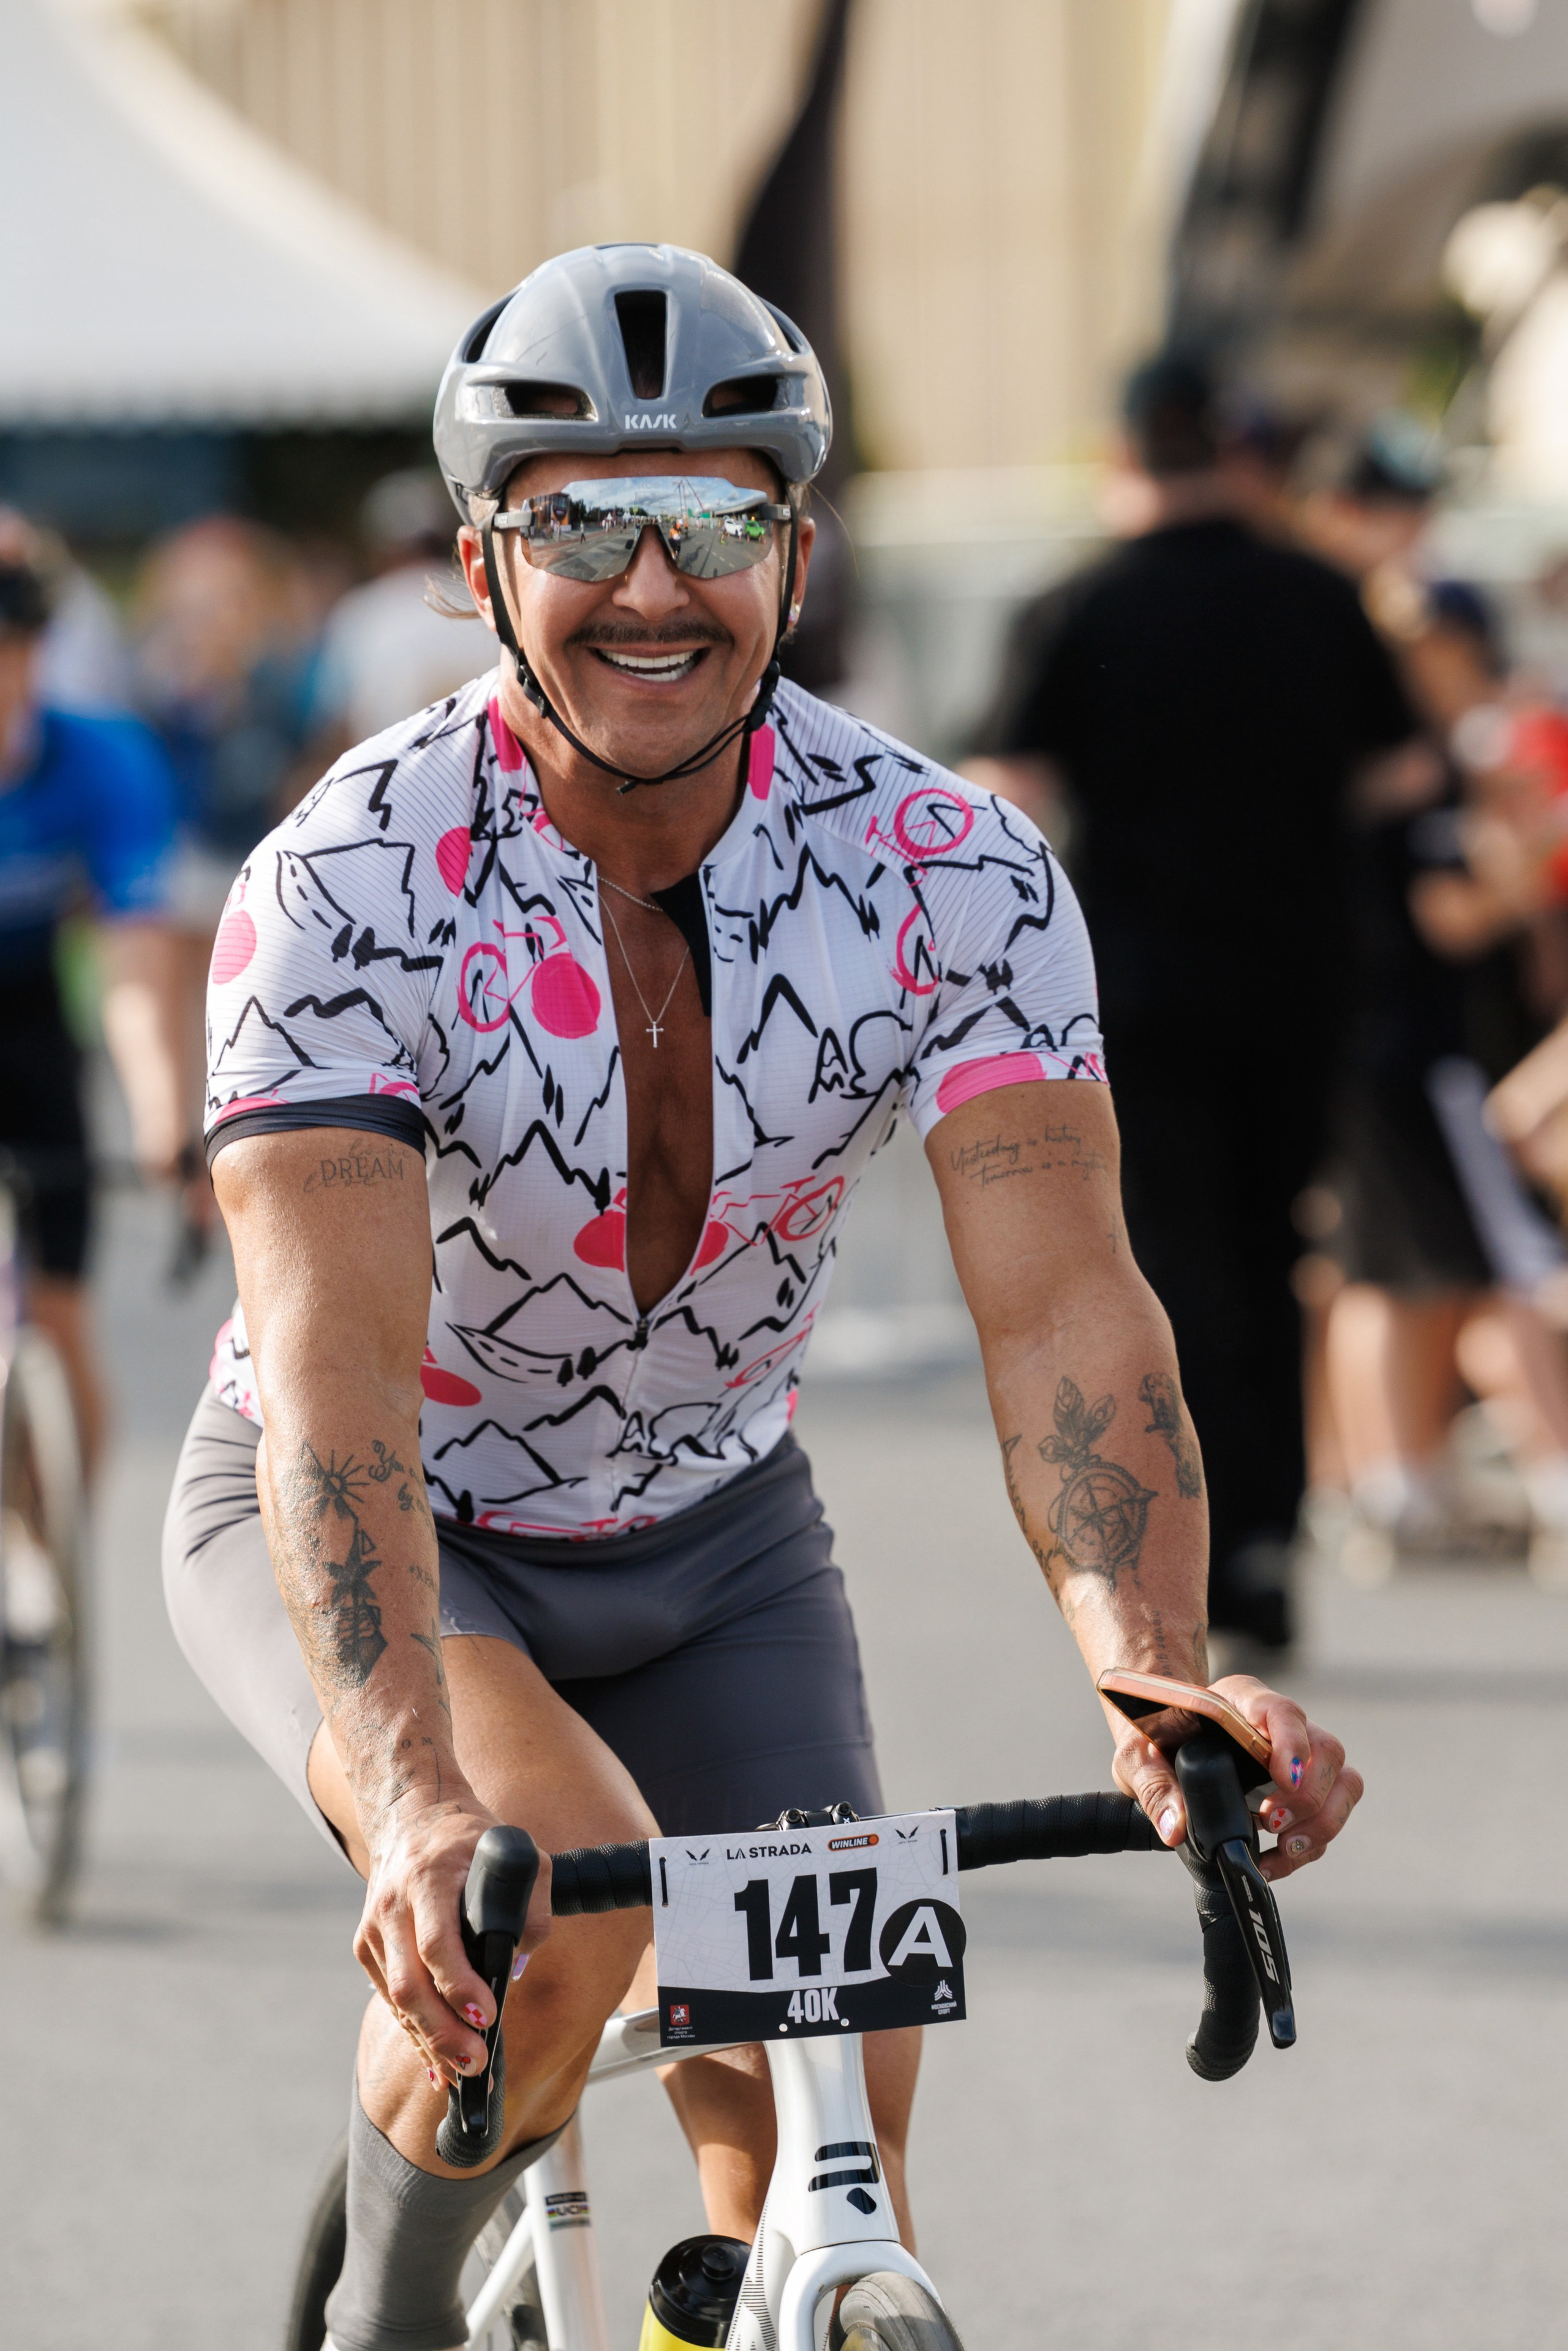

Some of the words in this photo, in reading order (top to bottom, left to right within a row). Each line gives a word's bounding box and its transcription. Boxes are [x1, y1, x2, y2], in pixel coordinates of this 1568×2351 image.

[625, 414, 677, 429] KASK
[320, 1157, 404, 1181] DREAM
[726, 1848, 746, 1860] LA
[749, 1843, 812, 1859] STRADA
[831, 1837, 869, 1849] WINLINE
[734, 1867, 878, 1981] 147
[888, 1906, 953, 1968] A
[1248, 1908, 1280, 1985] 105
[787, 1987, 840, 2023] 40K
